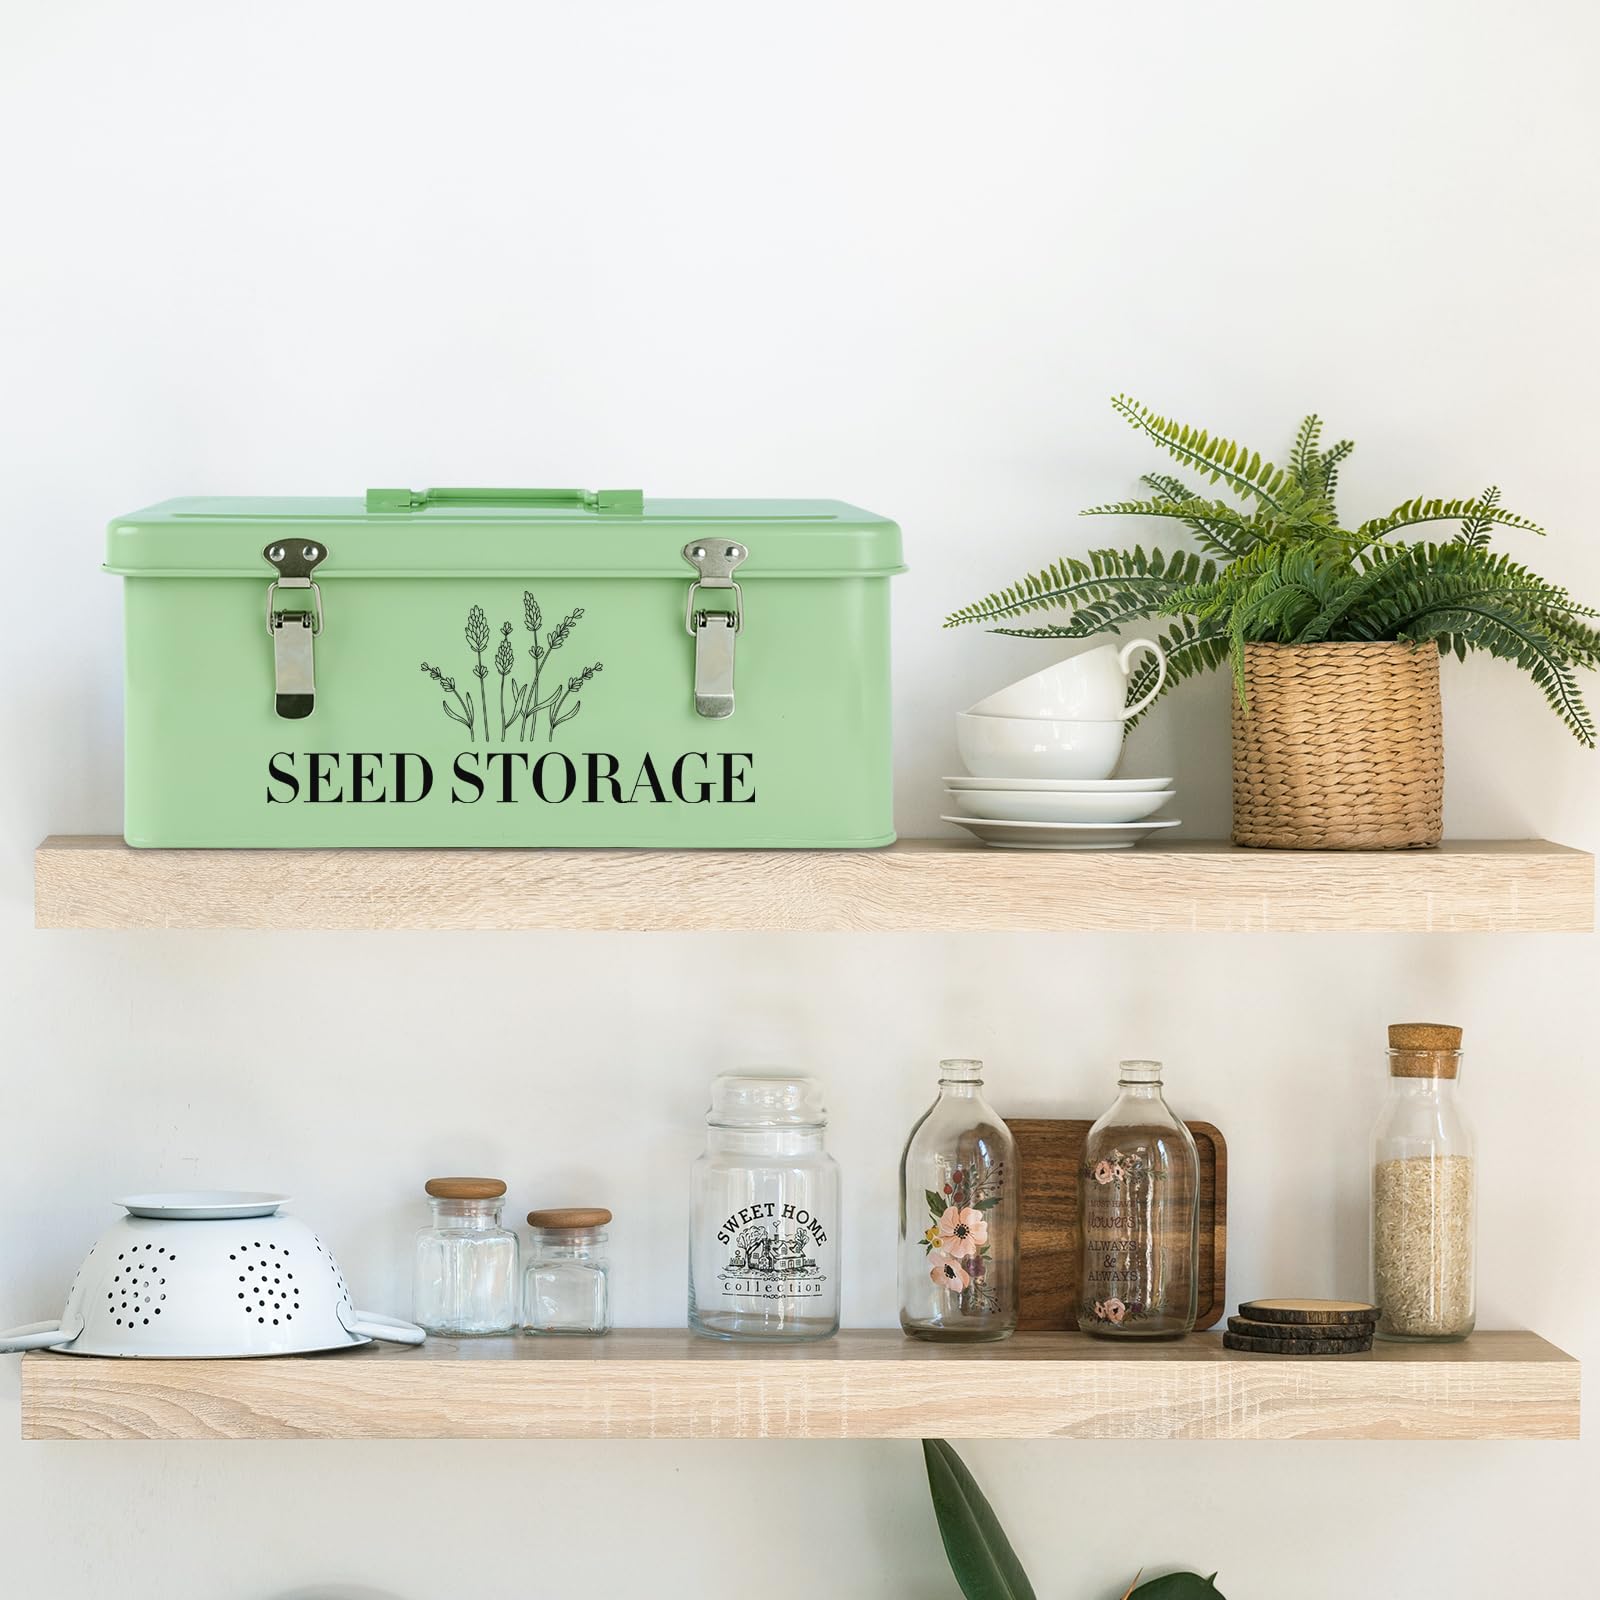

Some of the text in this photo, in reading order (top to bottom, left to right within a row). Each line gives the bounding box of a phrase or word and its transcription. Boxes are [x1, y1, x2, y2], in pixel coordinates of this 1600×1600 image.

[267, 752, 756, 804] SEED STORAGE
[717, 1203, 827, 1246] SWEET HOME
[1087, 1240, 1137, 1251] ALWAYS
[1103, 1254, 1117, 1268] &
[1087, 1270, 1138, 1282] ALWAYS
[724, 1281, 821, 1293] collection
